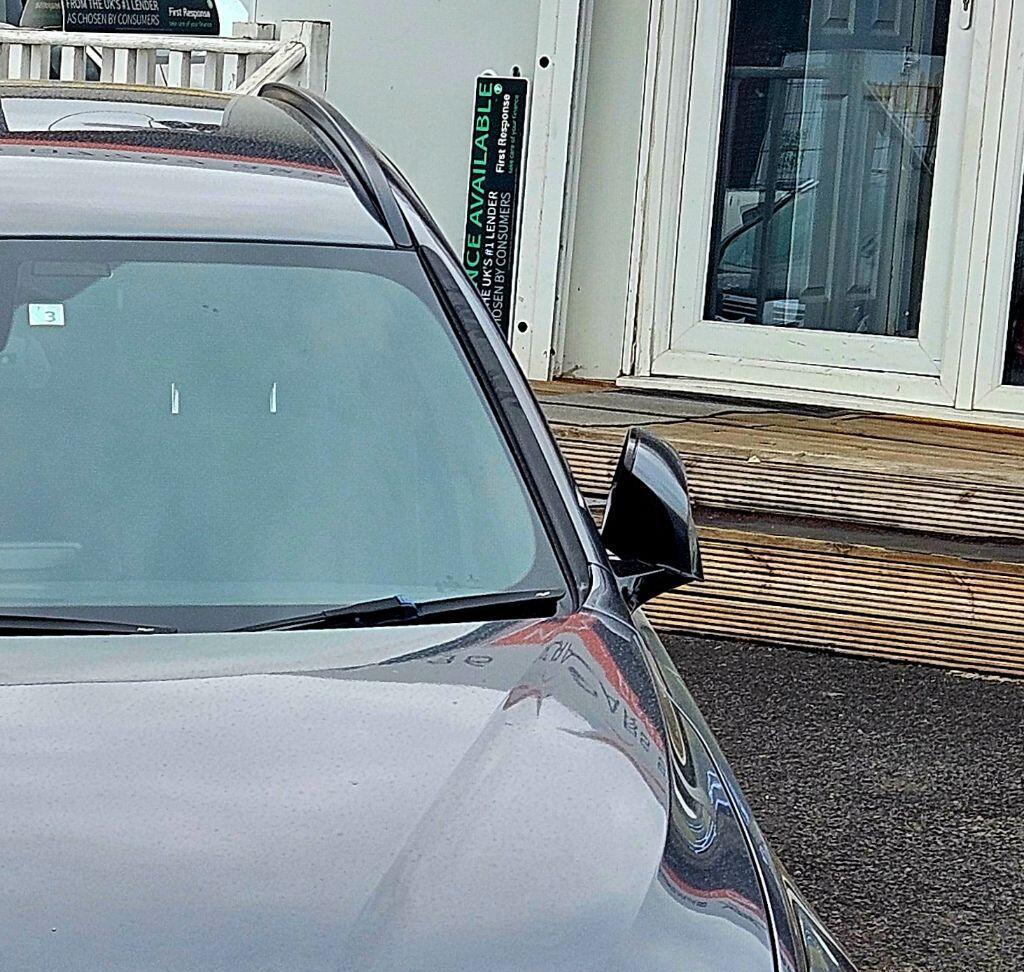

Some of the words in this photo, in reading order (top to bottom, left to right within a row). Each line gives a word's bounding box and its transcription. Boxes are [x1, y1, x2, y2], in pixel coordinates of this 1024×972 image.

[67, 12, 76, 24] AS
[77, 13, 107, 25] CHOSEN
[108, 13, 116, 25] BY
[117, 13, 160, 26] CONSUMERS
[89, 0, 103, 9] THE
[132, 0, 160, 11] LENDER
[182, 7, 211, 20] Response
[497, 93, 511, 146] Response
[469, 82, 493, 228] AVAILABLE
[495, 149, 506, 173] First
[485, 190, 498, 239] LENDER
[495, 192, 511, 267] CONSUMERS
[466, 233, 482, 289] NCE
[481, 257, 493, 286] UK'S
[494, 268, 505, 286] BY
[481, 289, 491, 308] HE
[491, 287, 504, 326] HOSEN
